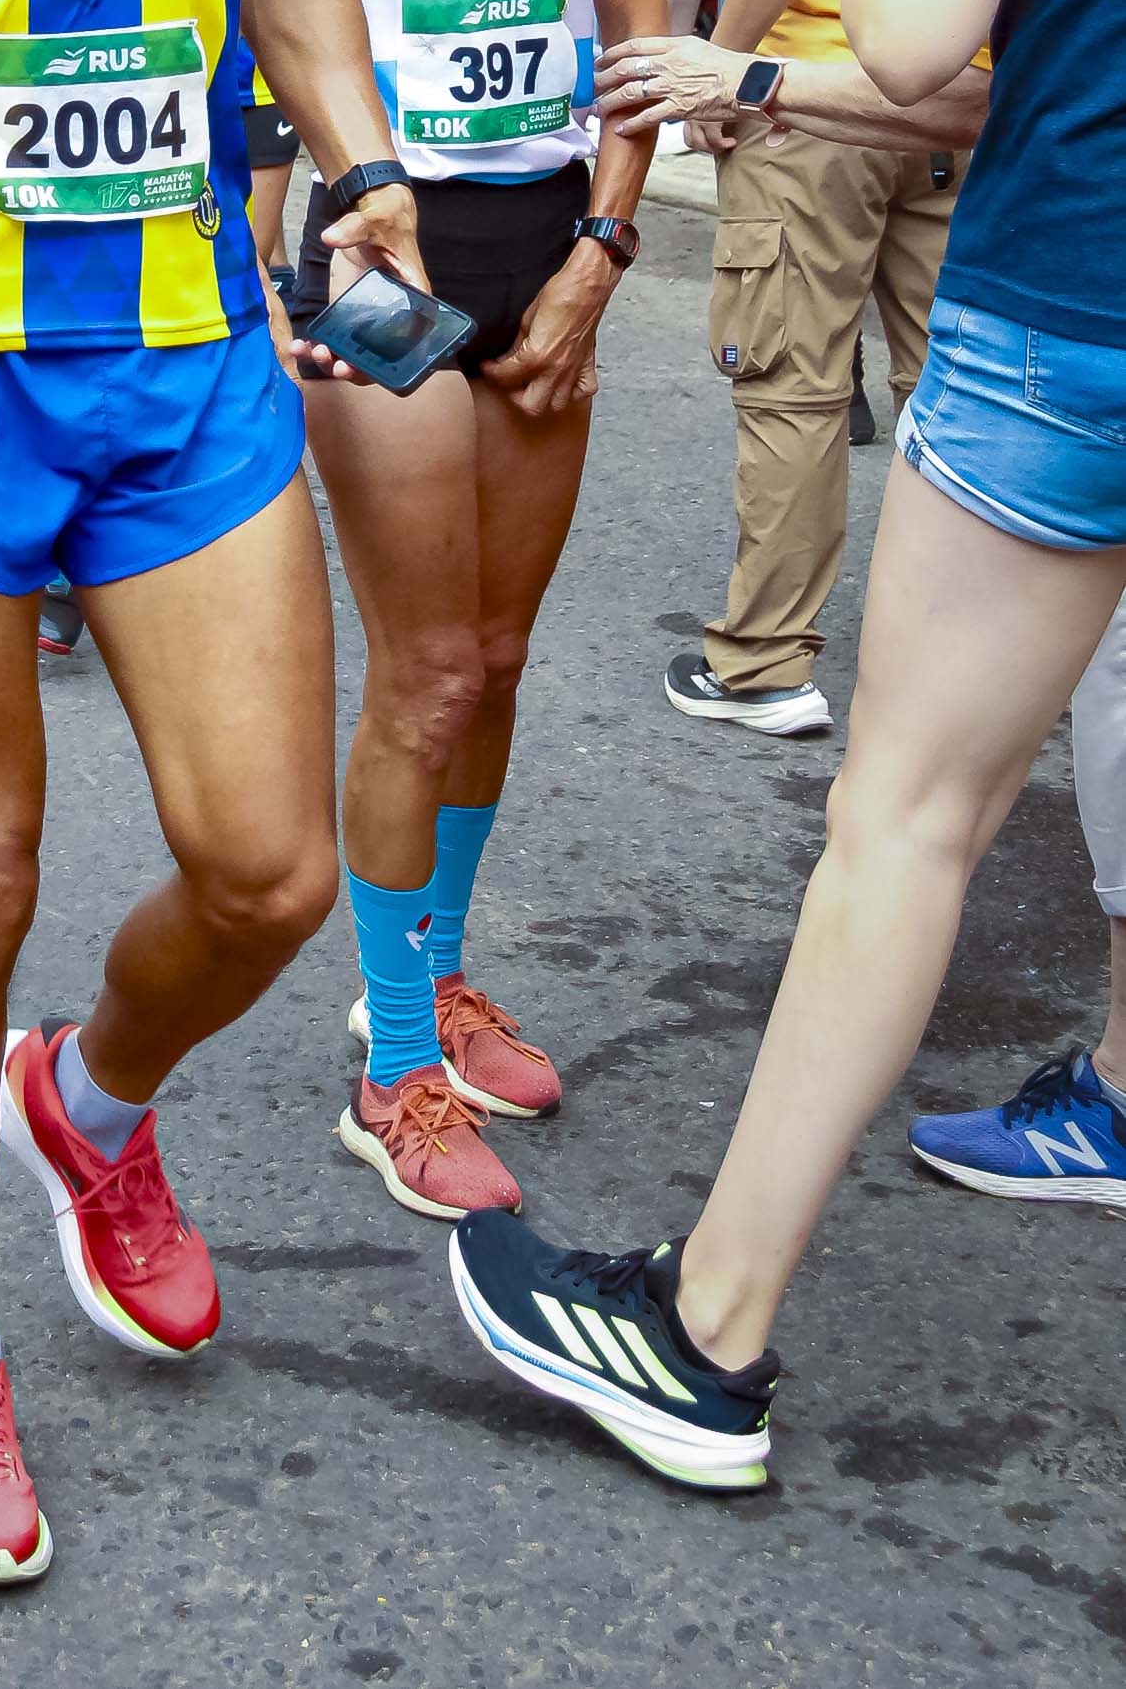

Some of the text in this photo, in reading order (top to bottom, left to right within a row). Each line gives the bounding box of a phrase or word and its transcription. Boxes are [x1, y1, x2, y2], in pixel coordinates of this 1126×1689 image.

[89, 47, 147, 72] RUS
[449, 37, 548, 103] 397
[3, 90, 186, 169] 2004
[420, 117, 471, 139] 10K
[143, 170, 193, 187] MARATÓN
[144, 181, 192, 196] CANALLA
[1, 184, 59, 209] 10K
